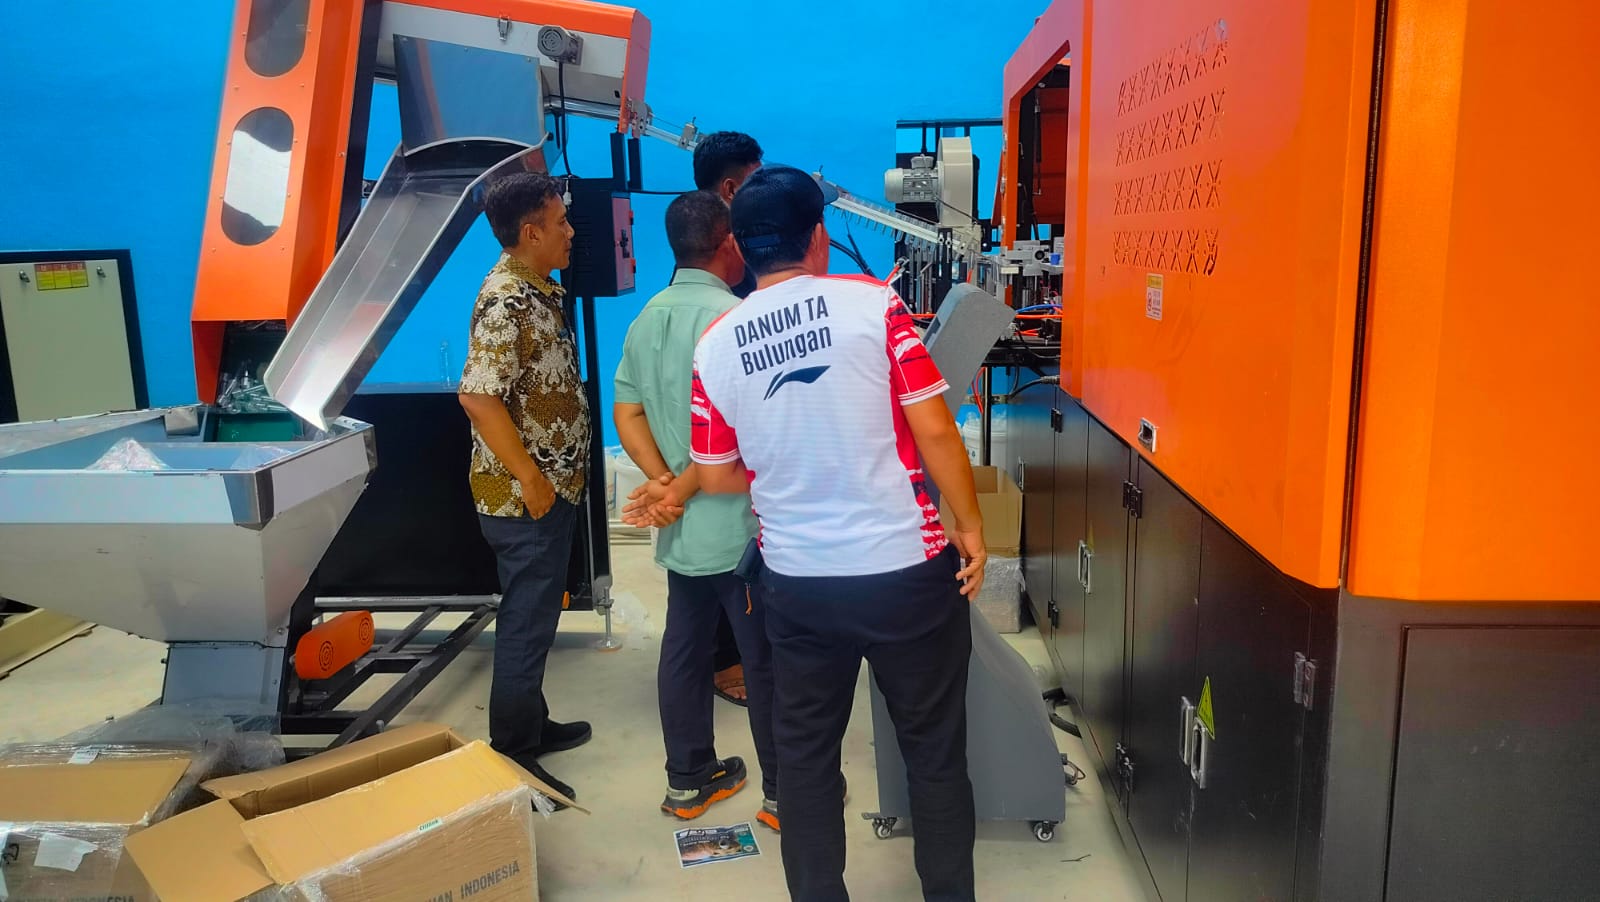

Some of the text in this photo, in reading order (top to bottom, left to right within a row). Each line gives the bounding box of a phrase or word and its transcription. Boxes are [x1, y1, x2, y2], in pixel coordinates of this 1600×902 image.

[734, 295, 829, 348] DANUM TA
[740, 326, 832, 376] Bulungan
[460, 861, 520, 899] INDONESIA
